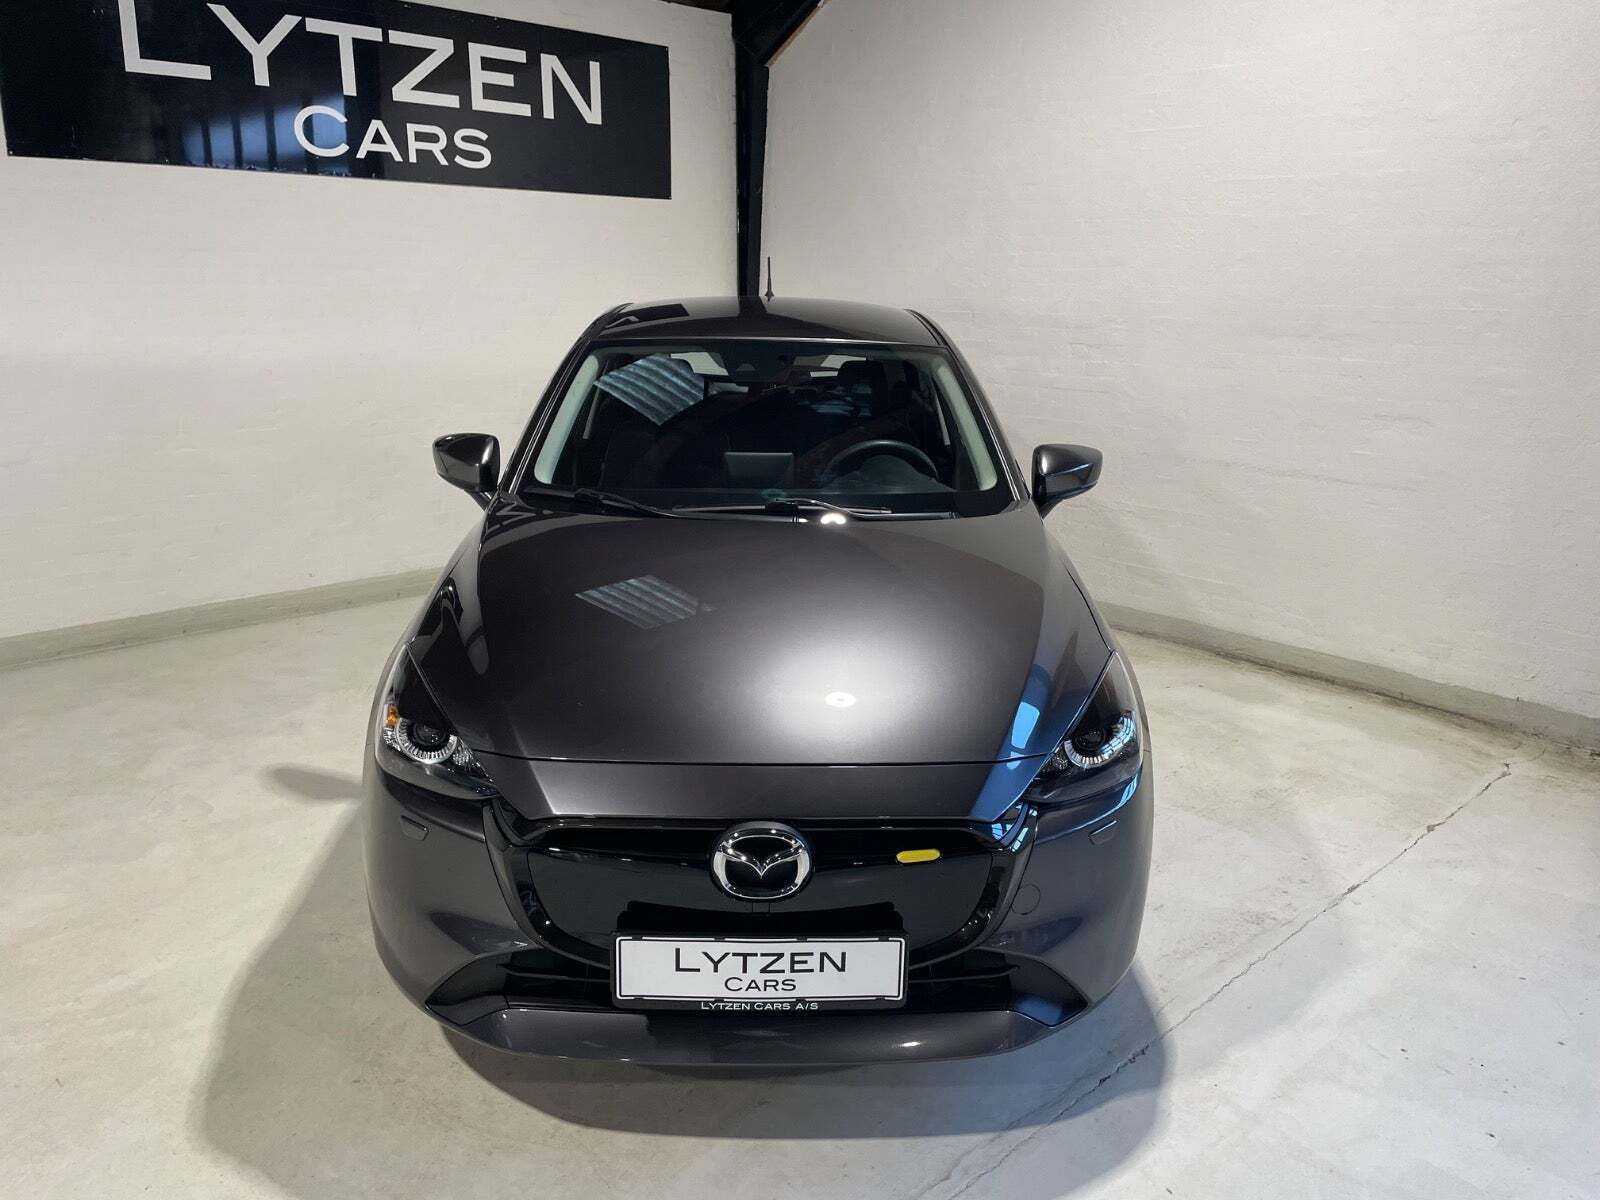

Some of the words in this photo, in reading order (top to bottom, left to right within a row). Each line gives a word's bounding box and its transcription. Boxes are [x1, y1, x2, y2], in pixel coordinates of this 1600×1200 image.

[119, 0, 602, 126] LYTZEN
[293, 105, 491, 169] CARS
[674, 947, 847, 974] LYTZEN
[724, 976, 797, 992] CARS
[701, 1001, 751, 1011] LYTZEN
[754, 1002, 791, 1011] CARS
[795, 1002, 819, 1011] A/S
